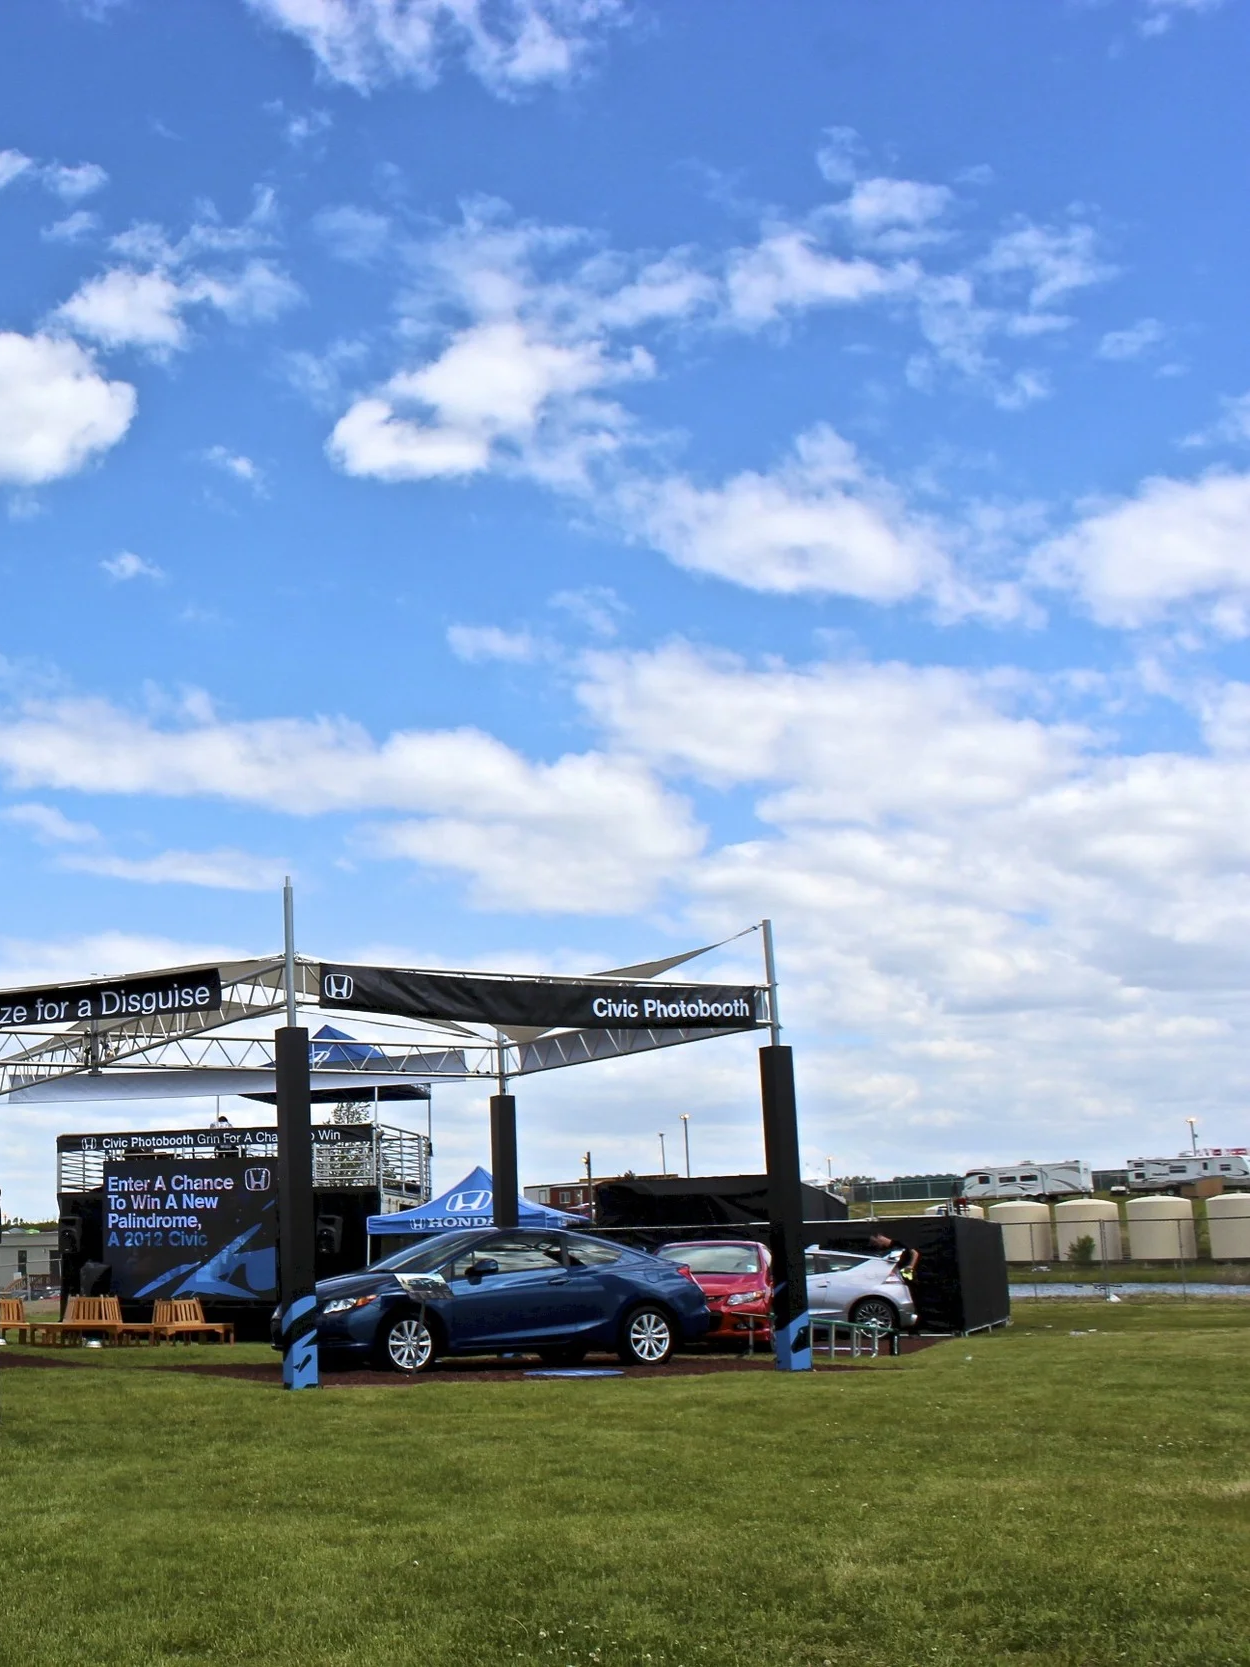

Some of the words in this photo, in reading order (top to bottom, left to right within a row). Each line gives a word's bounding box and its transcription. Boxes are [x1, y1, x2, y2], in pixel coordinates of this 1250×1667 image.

[35, 998, 67, 1022] for
[77, 999, 93, 1018] a
[100, 983, 210, 1016] Disguise
[592, 998, 638, 1018] Civic
[644, 998, 750, 1018] Photobooth
[102, 1137, 128, 1149] Civic
[131, 1134, 194, 1148] Photobooth
[197, 1132, 220, 1145] Grin
[223, 1132, 241, 1144] For
[244, 1132, 253, 1143] A
[255, 1131, 278, 1142] Cha
[318, 1130, 341, 1141] Win
[108, 1176, 150, 1192] Enter
[154, 1175, 167, 1191] A
[171, 1174, 234, 1191] Chance
[107, 1194, 127, 1211] To
[131, 1194, 160, 1210] Win
[165, 1194, 178, 1210] A
[182, 1193, 219, 1209] New
[108, 1212, 202, 1230] Palindrome,
[107, 1231, 120, 1247] A
[124, 1231, 163, 1247] 2012
[168, 1230, 208, 1247] Civic
